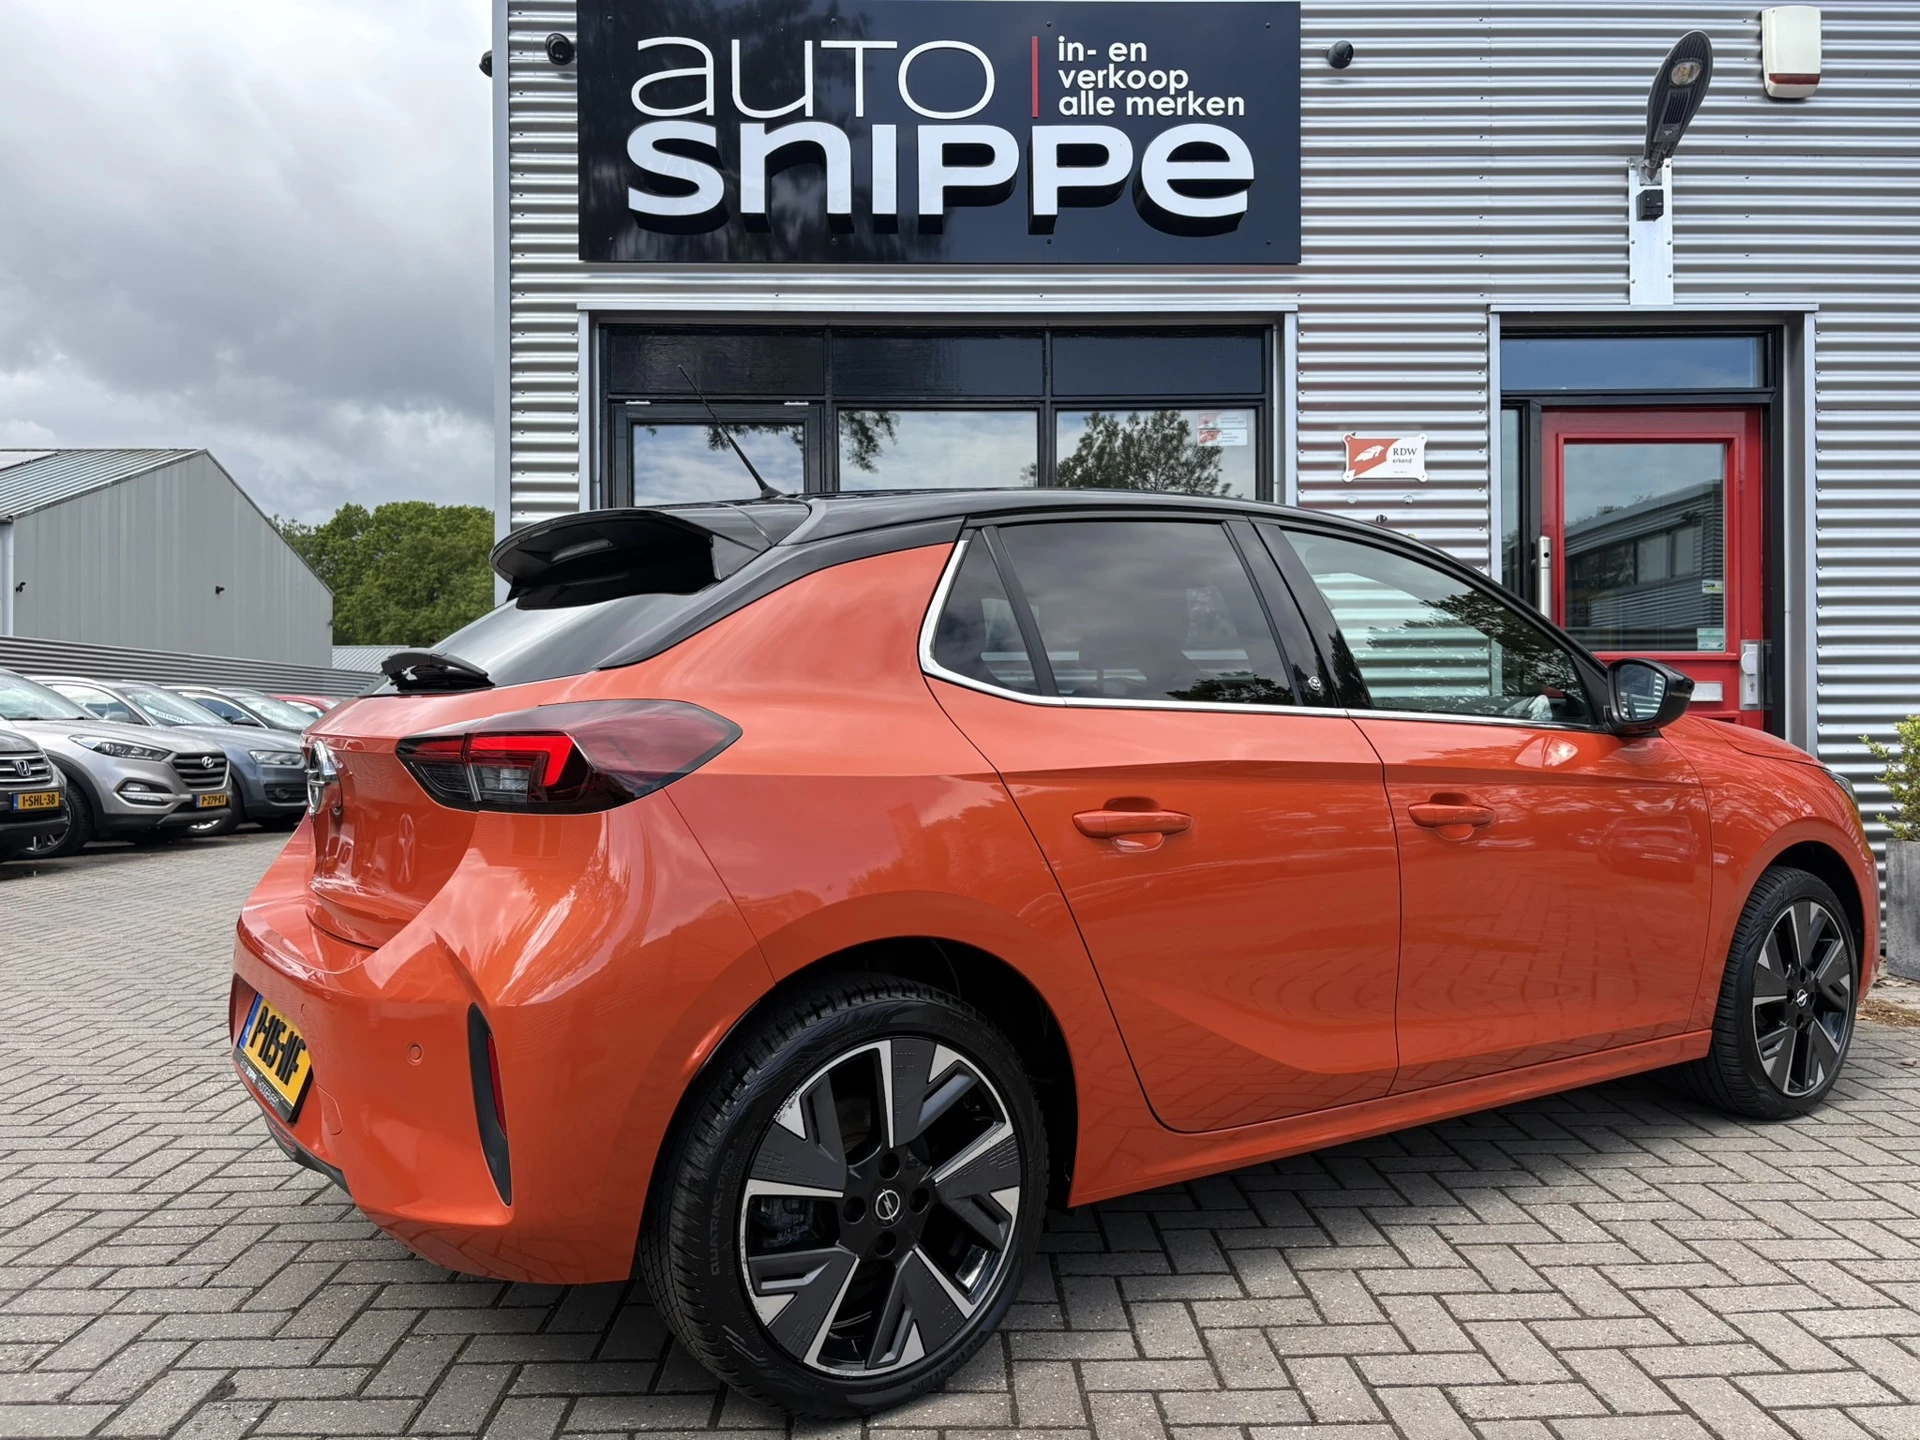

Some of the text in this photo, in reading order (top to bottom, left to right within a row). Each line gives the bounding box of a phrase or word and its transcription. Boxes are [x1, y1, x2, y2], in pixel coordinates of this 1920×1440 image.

[1058, 36, 1148, 62] in- en
[1058, 63, 1189, 95] verkoop
[1058, 90, 1245, 116] alle merken
[1393, 447, 1418, 456] RDW
[22, 794, 56, 807] 1-SHL-38
[709, 1149, 736, 1276] QUATRAC PRO
